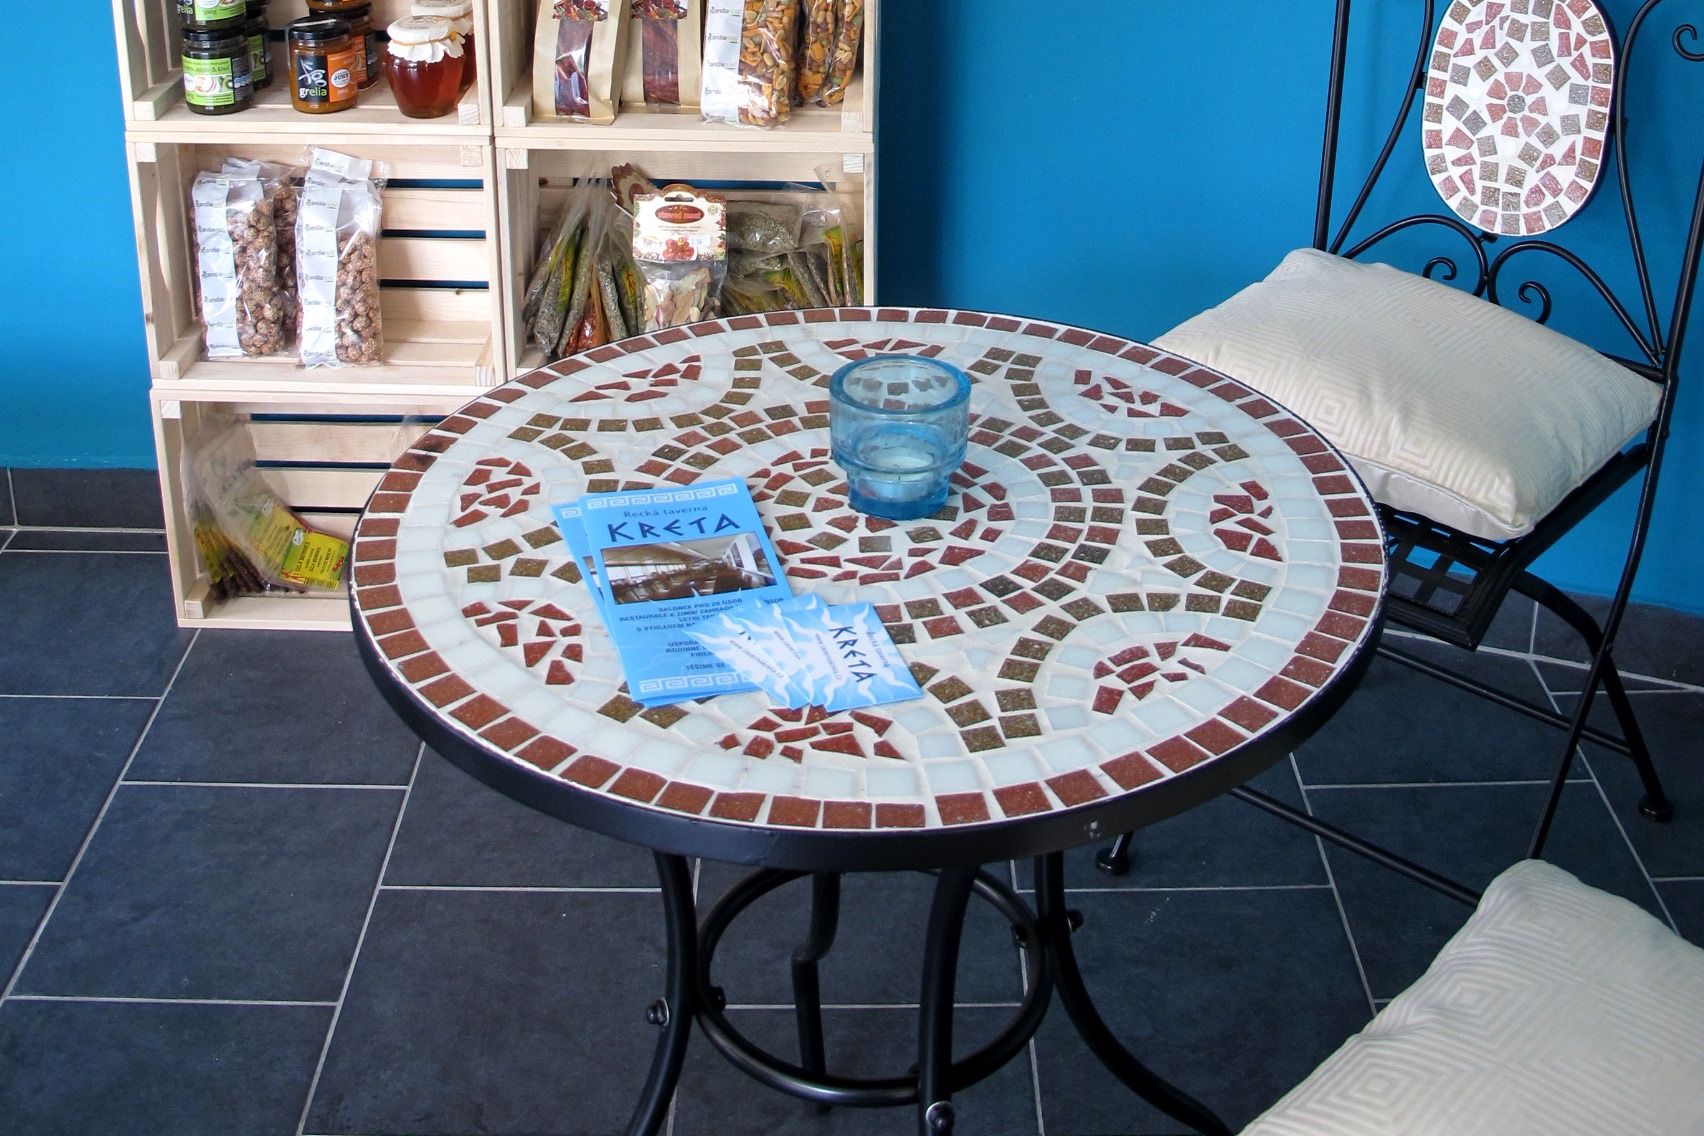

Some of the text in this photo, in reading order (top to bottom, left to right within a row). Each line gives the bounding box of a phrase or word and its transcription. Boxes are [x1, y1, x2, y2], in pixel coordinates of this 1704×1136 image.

[177, 4, 193, 14] relia
[300, 87, 327, 98] grelia
[664, 505, 708, 515] taverna
[607, 513, 740, 543] KRETA
[658, 604, 692, 612] SALONEK
[644, 623, 684, 631] VYHLEDEM
[829, 626, 877, 682] KRETA
